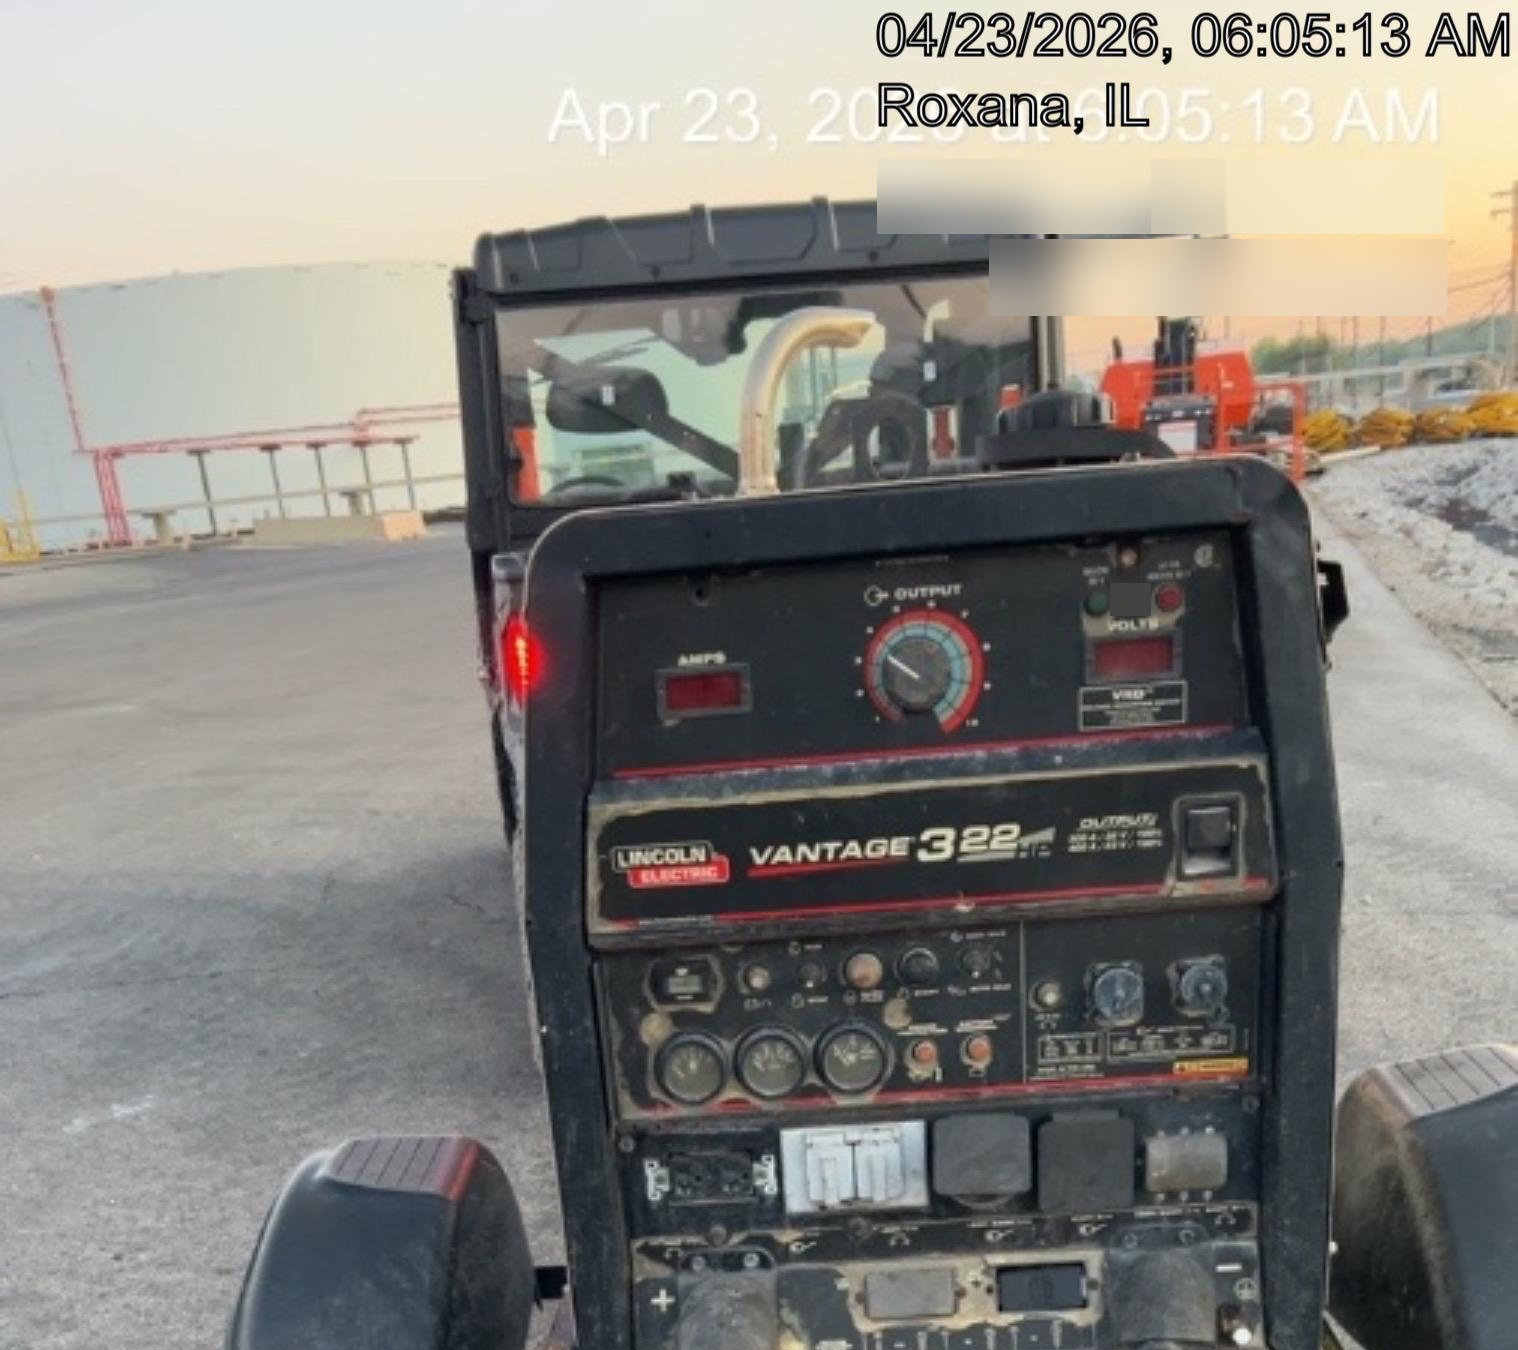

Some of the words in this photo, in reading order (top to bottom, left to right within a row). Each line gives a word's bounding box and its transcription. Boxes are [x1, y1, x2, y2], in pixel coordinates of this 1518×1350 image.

[894, 584, 963, 600] OUTPUT
[677, 651, 727, 667] AMPS
[750, 836, 911, 866] VANTAGE
[916, 822, 1022, 863] 322
[616, 846, 706, 868] LINCOLN
[640, 865, 718, 884] ELECTRIC
